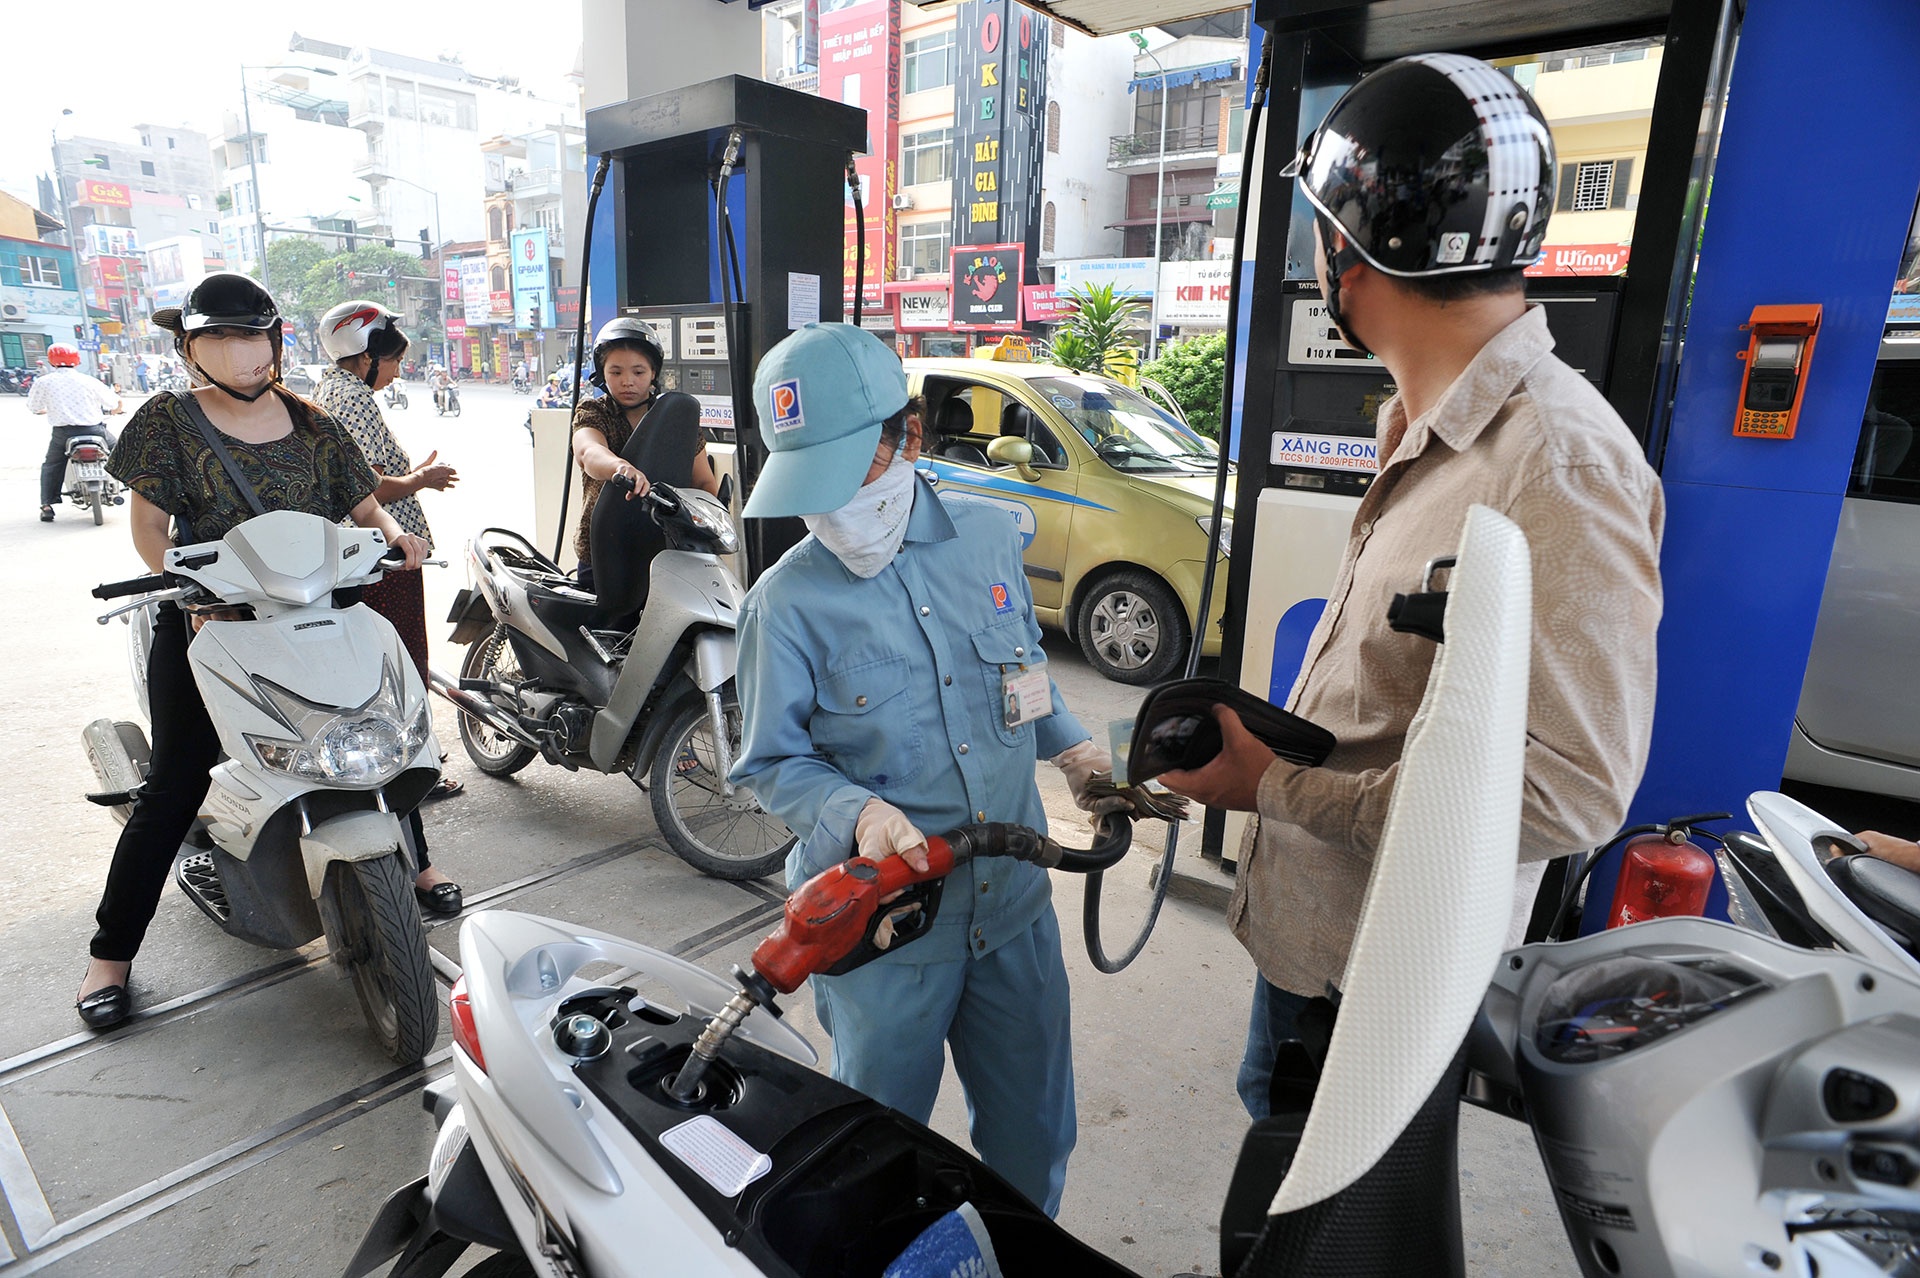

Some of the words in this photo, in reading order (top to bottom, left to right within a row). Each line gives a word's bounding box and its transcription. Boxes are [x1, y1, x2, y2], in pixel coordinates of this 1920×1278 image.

[888, 53, 899, 120] MAGIC
[975, 135, 998, 162] HÁT
[975, 170, 997, 192] GIA
[971, 197, 998, 223] ĐÌNH
[1555, 250, 1618, 271] Winny
[963, 256, 1007, 285] KARAOKE
[1177, 286, 1203, 301] KIM
[903, 297, 931, 309] NEW
[970, 305, 987, 313] ROMA
[988, 304, 1003, 313] CLUB
[1009, 337, 1024, 347] TAXI
[1006, 348, 1028, 360] METER
[1314, 349, 1324, 359] 10
[1326, 349, 1332, 359] X
[705, 407, 722, 418] RON
[723, 408, 732, 419] 92
[1281, 437, 1331, 454] XĂNG
[1337, 442, 1376, 459] RON
[1280, 452, 1302, 463] TCCS
[1304, 454, 1318, 464] 01:
[294, 618, 336, 632] HONDA
[221, 792, 251, 815] HONDA
